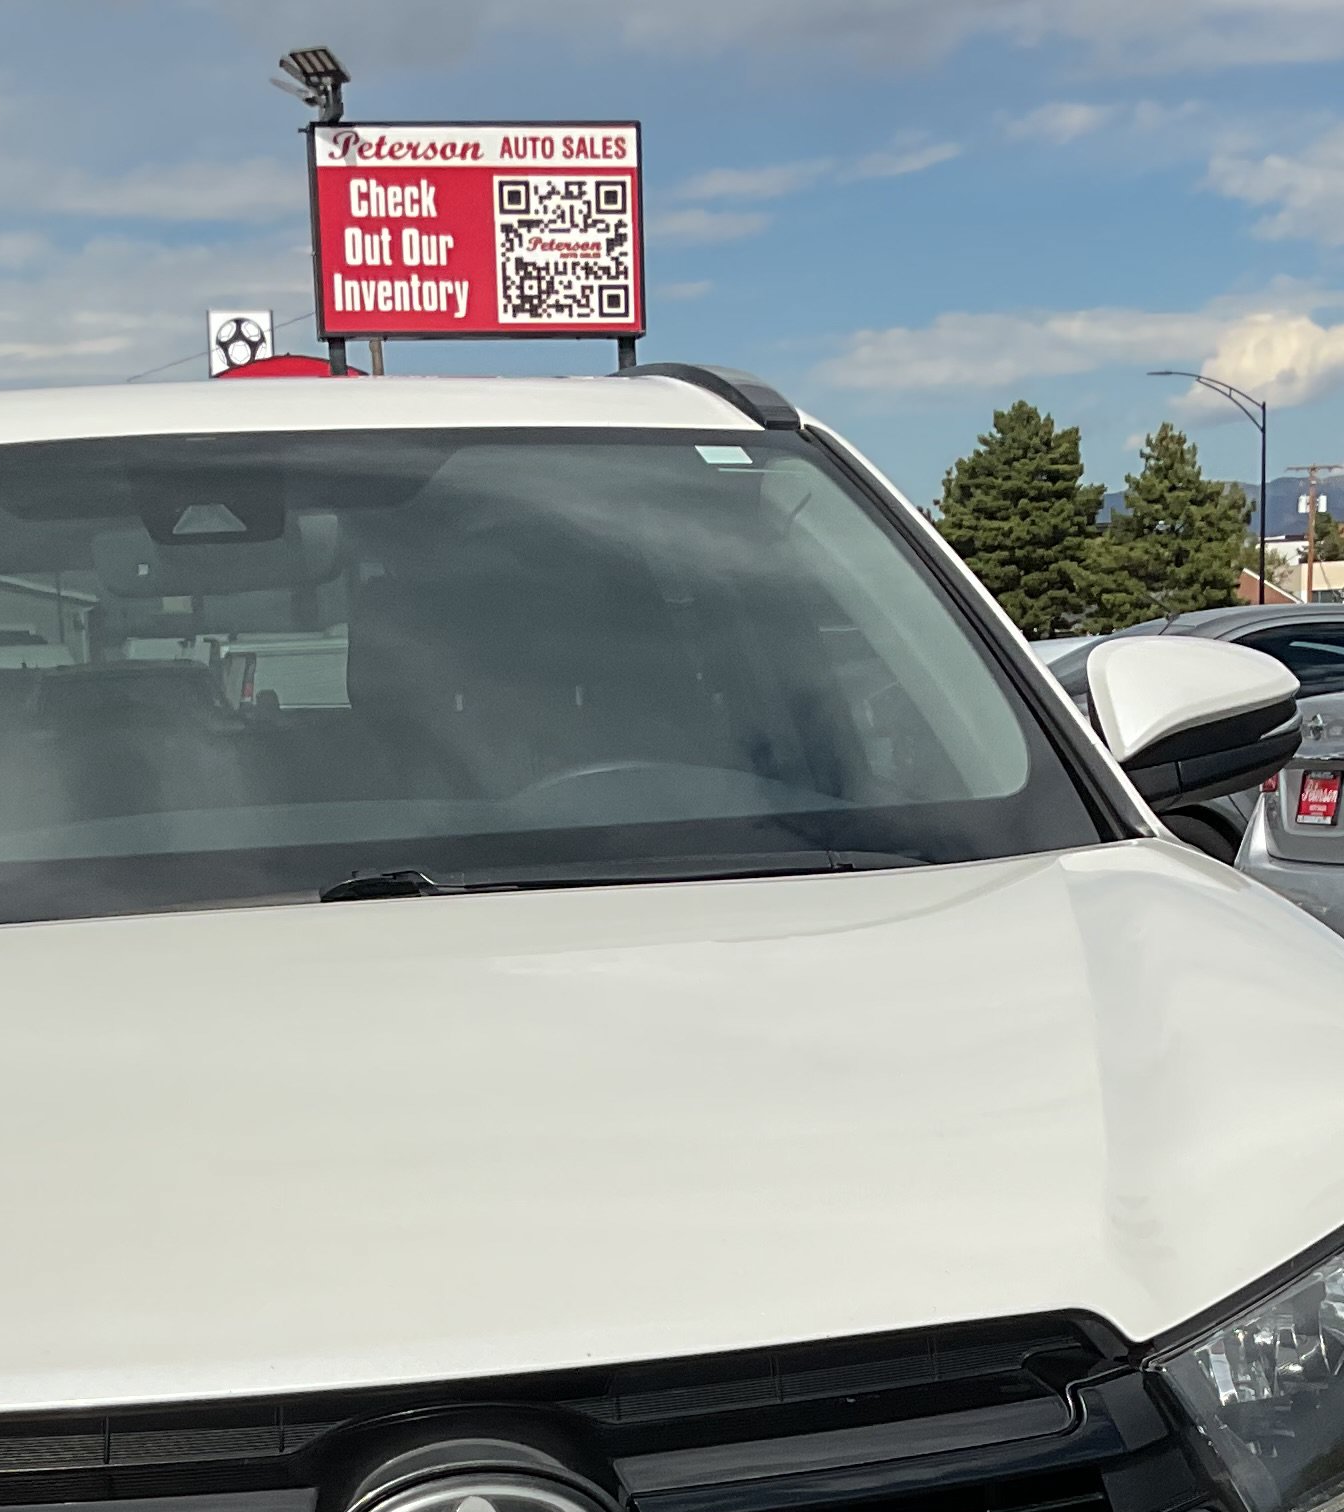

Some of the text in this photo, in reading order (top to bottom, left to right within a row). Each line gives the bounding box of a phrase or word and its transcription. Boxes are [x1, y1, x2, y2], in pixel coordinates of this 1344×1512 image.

[328, 130, 627, 161] Peterson AUTO SALES
[349, 178, 438, 218] Check
[344, 226, 455, 266] Out Our
[333, 272, 470, 319] Inventory
